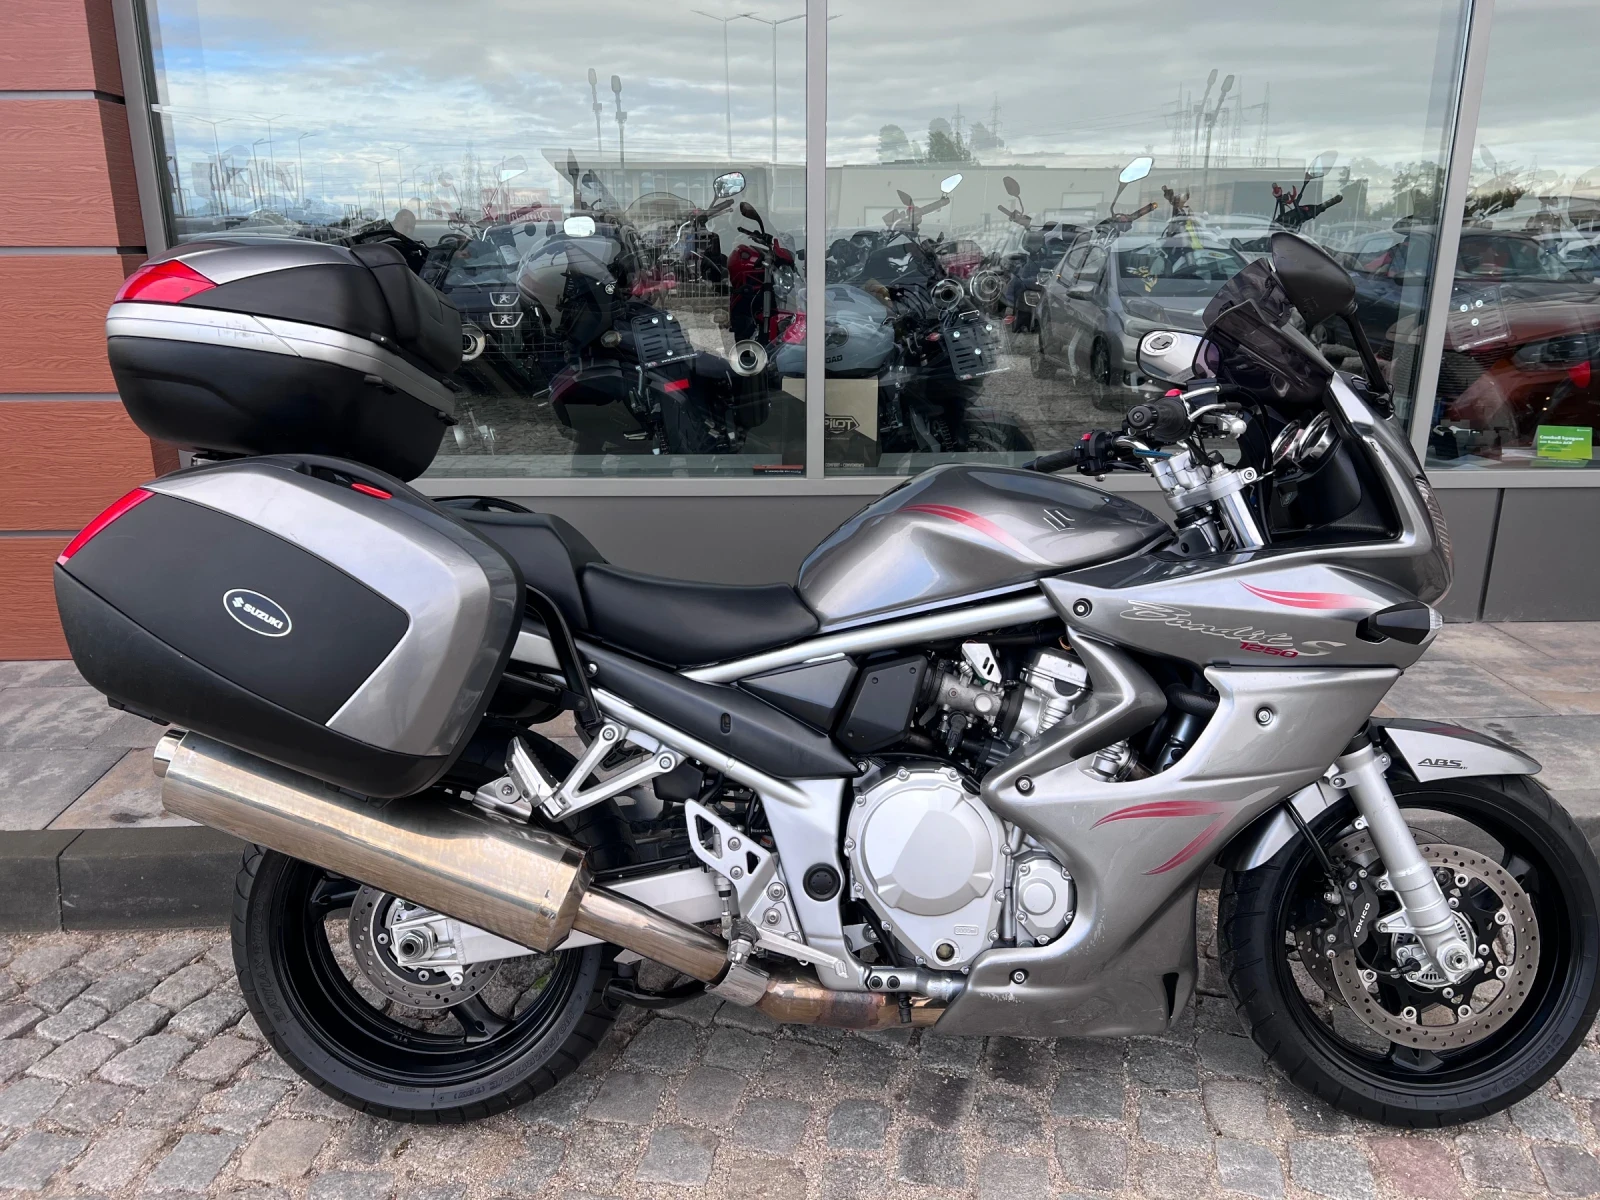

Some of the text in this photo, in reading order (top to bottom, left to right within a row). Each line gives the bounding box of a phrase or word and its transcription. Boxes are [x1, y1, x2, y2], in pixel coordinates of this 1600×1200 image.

[243, 603, 284, 629] SUZUKI
[1120, 600, 1347, 656] Bandit S
[1239, 642, 1299, 659] 1250
[1418, 758, 1463, 768] ABS
[1353, 902, 1371, 938] TOKICO
